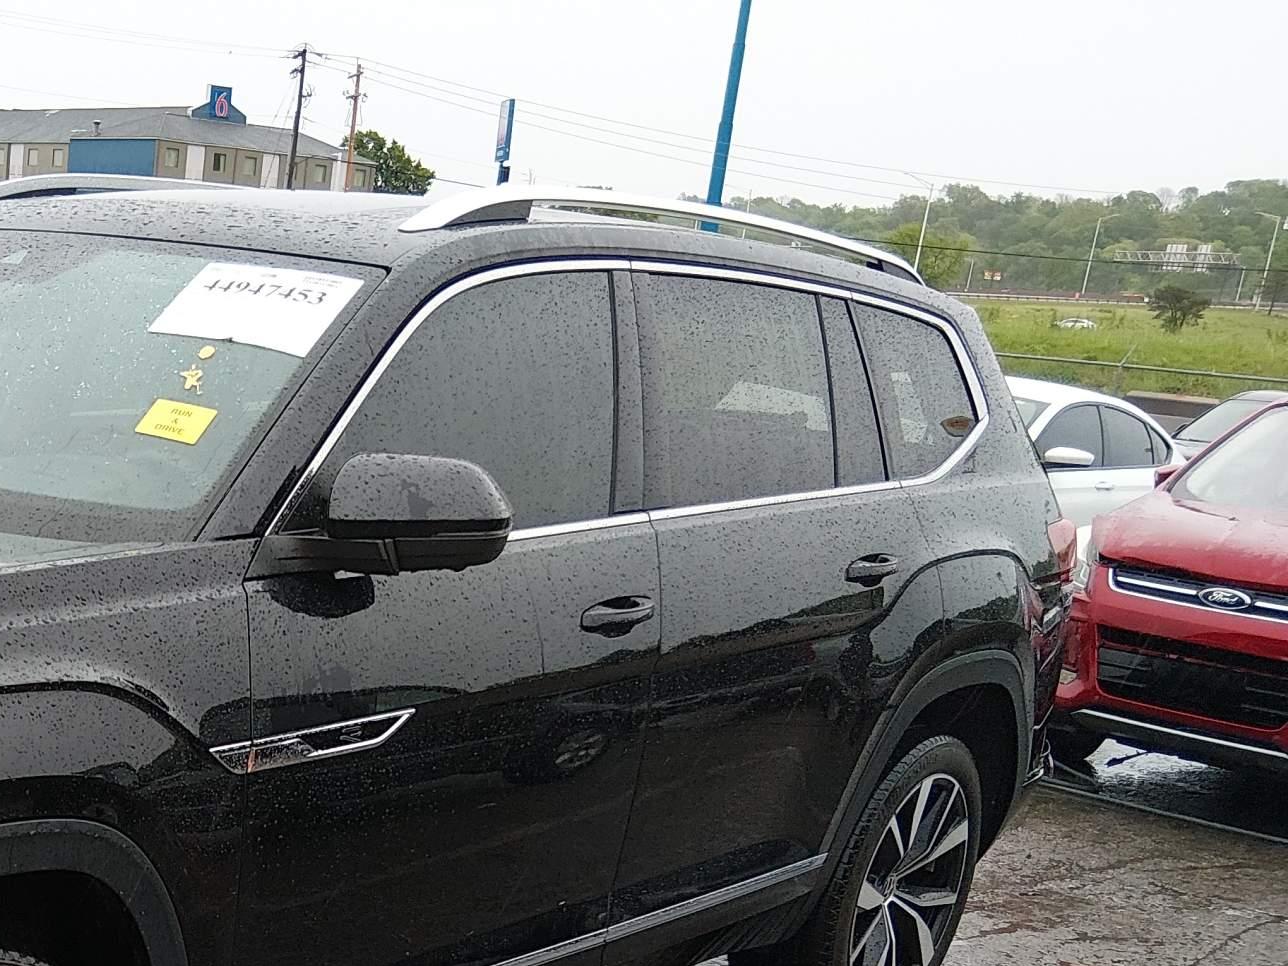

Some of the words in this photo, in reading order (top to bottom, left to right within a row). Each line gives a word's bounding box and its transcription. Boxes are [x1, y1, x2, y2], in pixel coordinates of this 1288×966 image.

[215, 92, 228, 117] 6
[203, 279, 327, 305] 44947453
[170, 408, 193, 417] RUN
[154, 423, 185, 435] DRIVE
[1208, 591, 1239, 604] Ford
